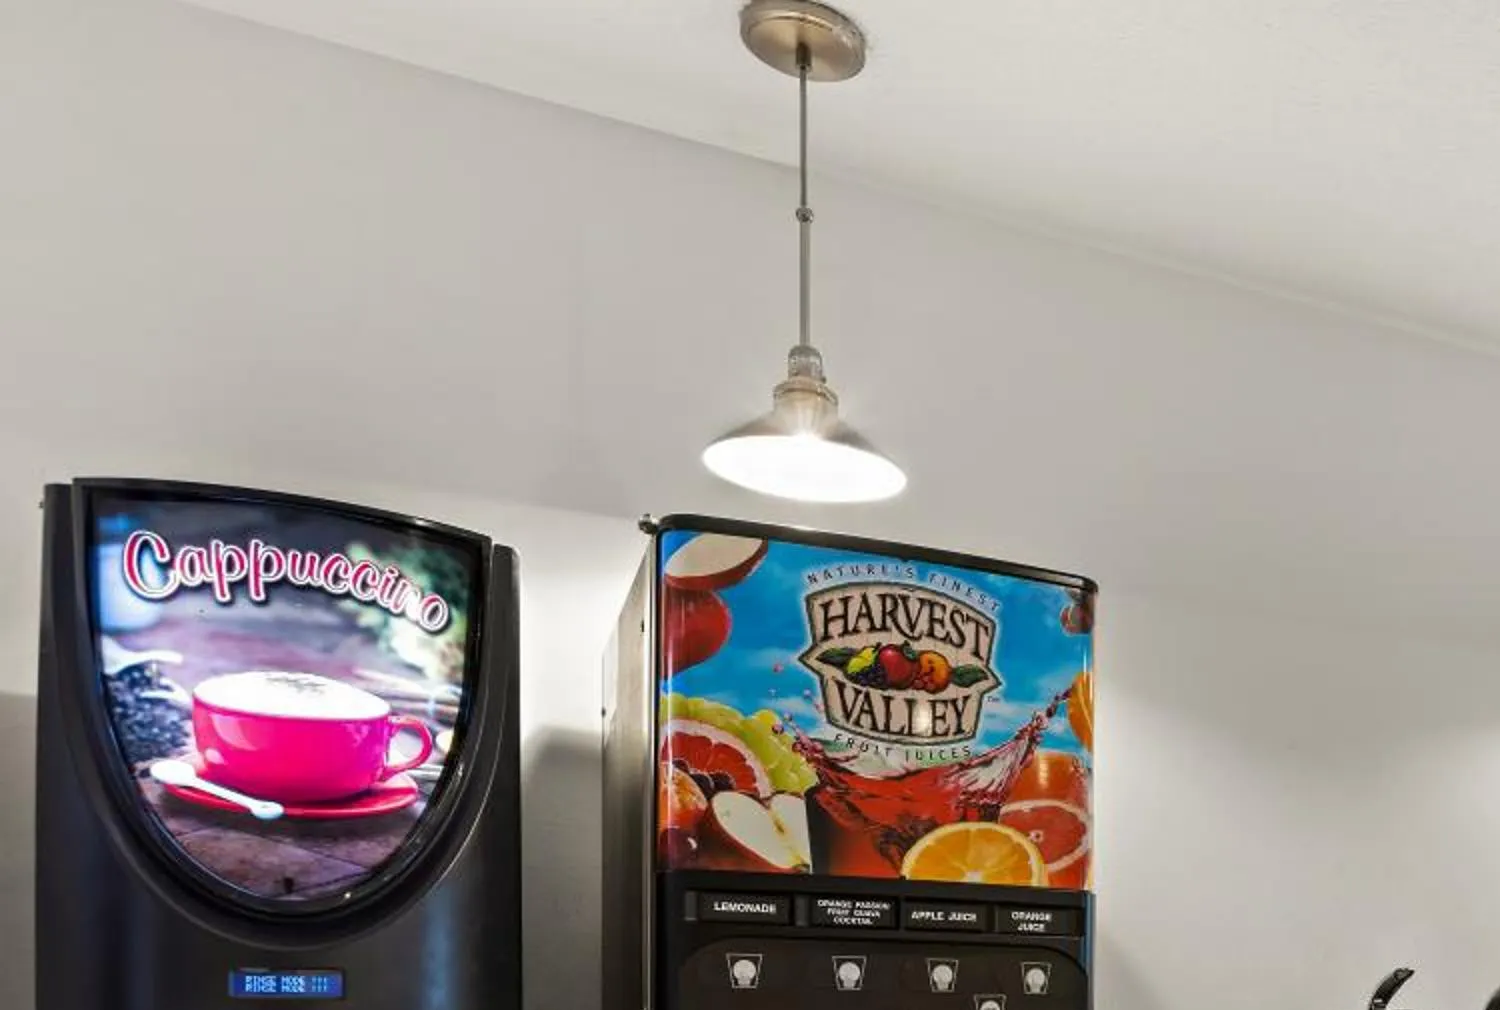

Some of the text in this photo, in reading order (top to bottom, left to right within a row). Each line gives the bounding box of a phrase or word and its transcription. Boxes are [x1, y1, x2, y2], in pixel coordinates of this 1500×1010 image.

[122, 529, 452, 633] Cappuccino
[807, 563, 1000, 612] NATURE'S FINEST
[819, 592, 989, 660] HARVEST
[834, 679, 972, 737] VALLEY
[834, 733, 971, 761] FRUIT JUICES
[713, 901, 777, 914] LEMONADE
[911, 911, 977, 922] APPLE JUICE
[1011, 911, 1052, 921] ORANGE
[1017, 923, 1046, 932] JUICE
